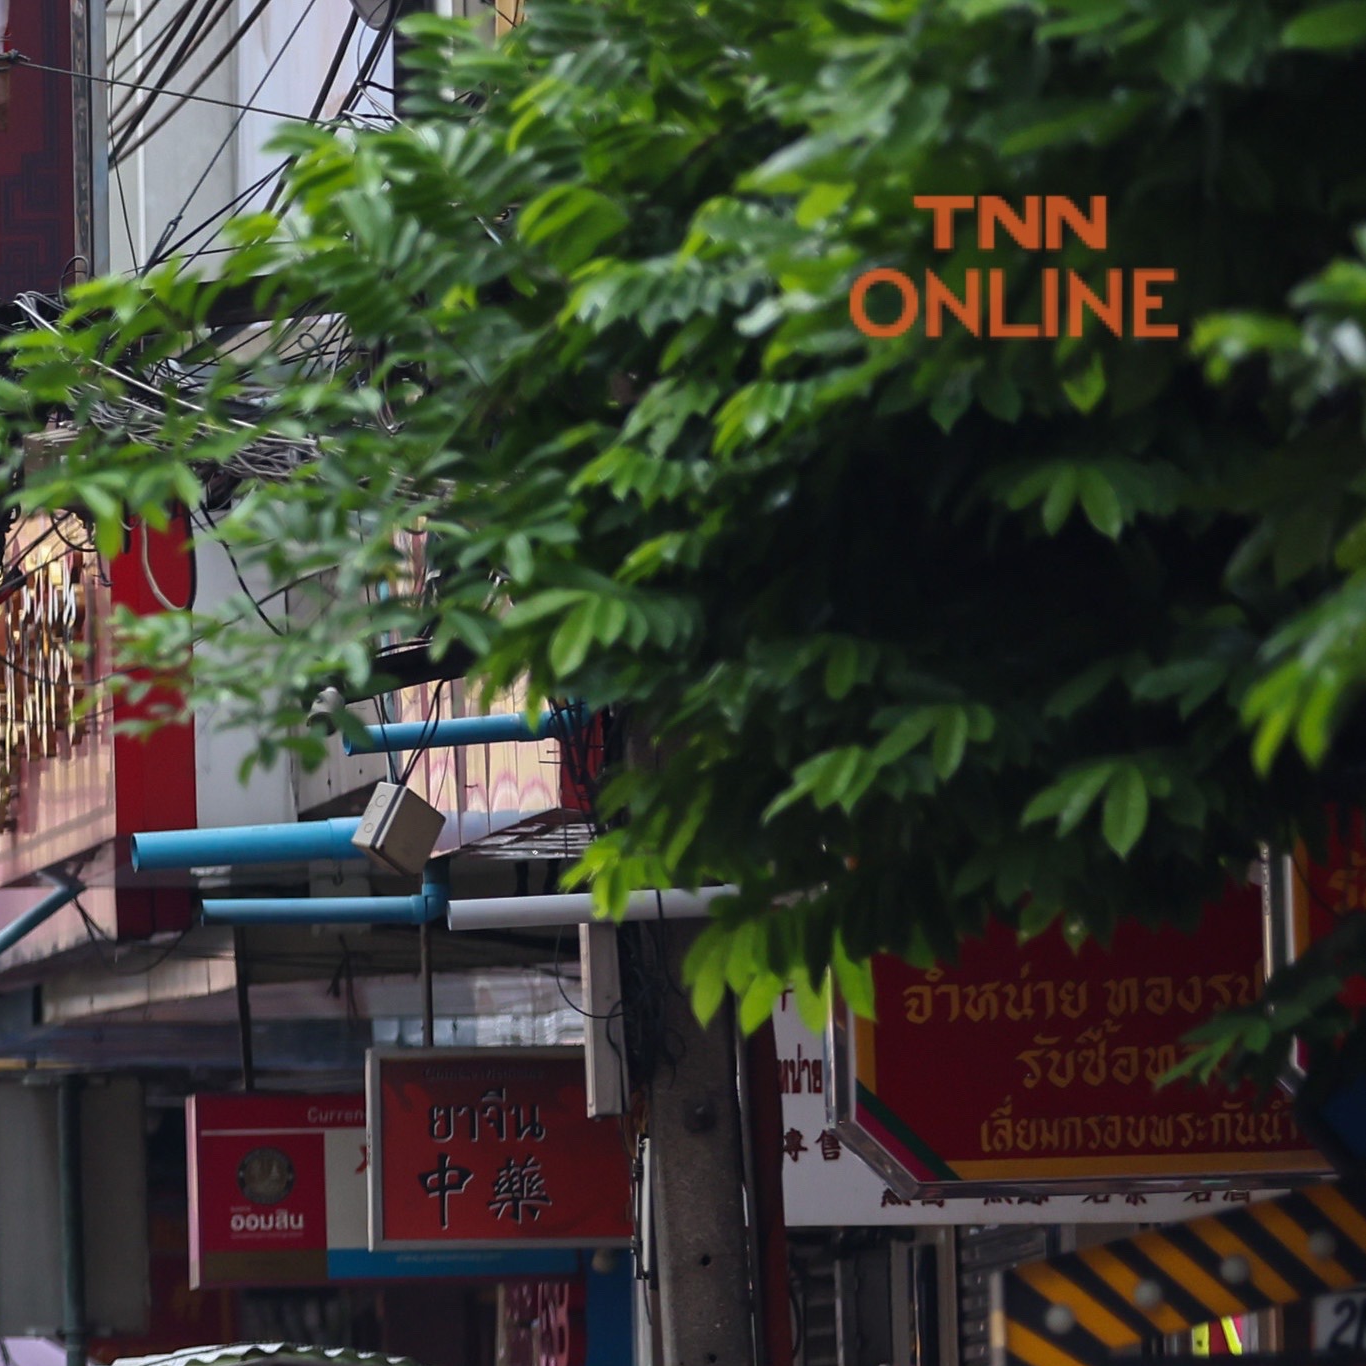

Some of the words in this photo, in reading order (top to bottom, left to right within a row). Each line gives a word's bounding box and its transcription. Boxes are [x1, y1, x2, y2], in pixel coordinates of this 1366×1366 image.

[429, 1087, 547, 1143] ยาจีน
[418, 1151, 553, 1230] 中藥
[230, 1208, 304, 1232] ออมสิน
